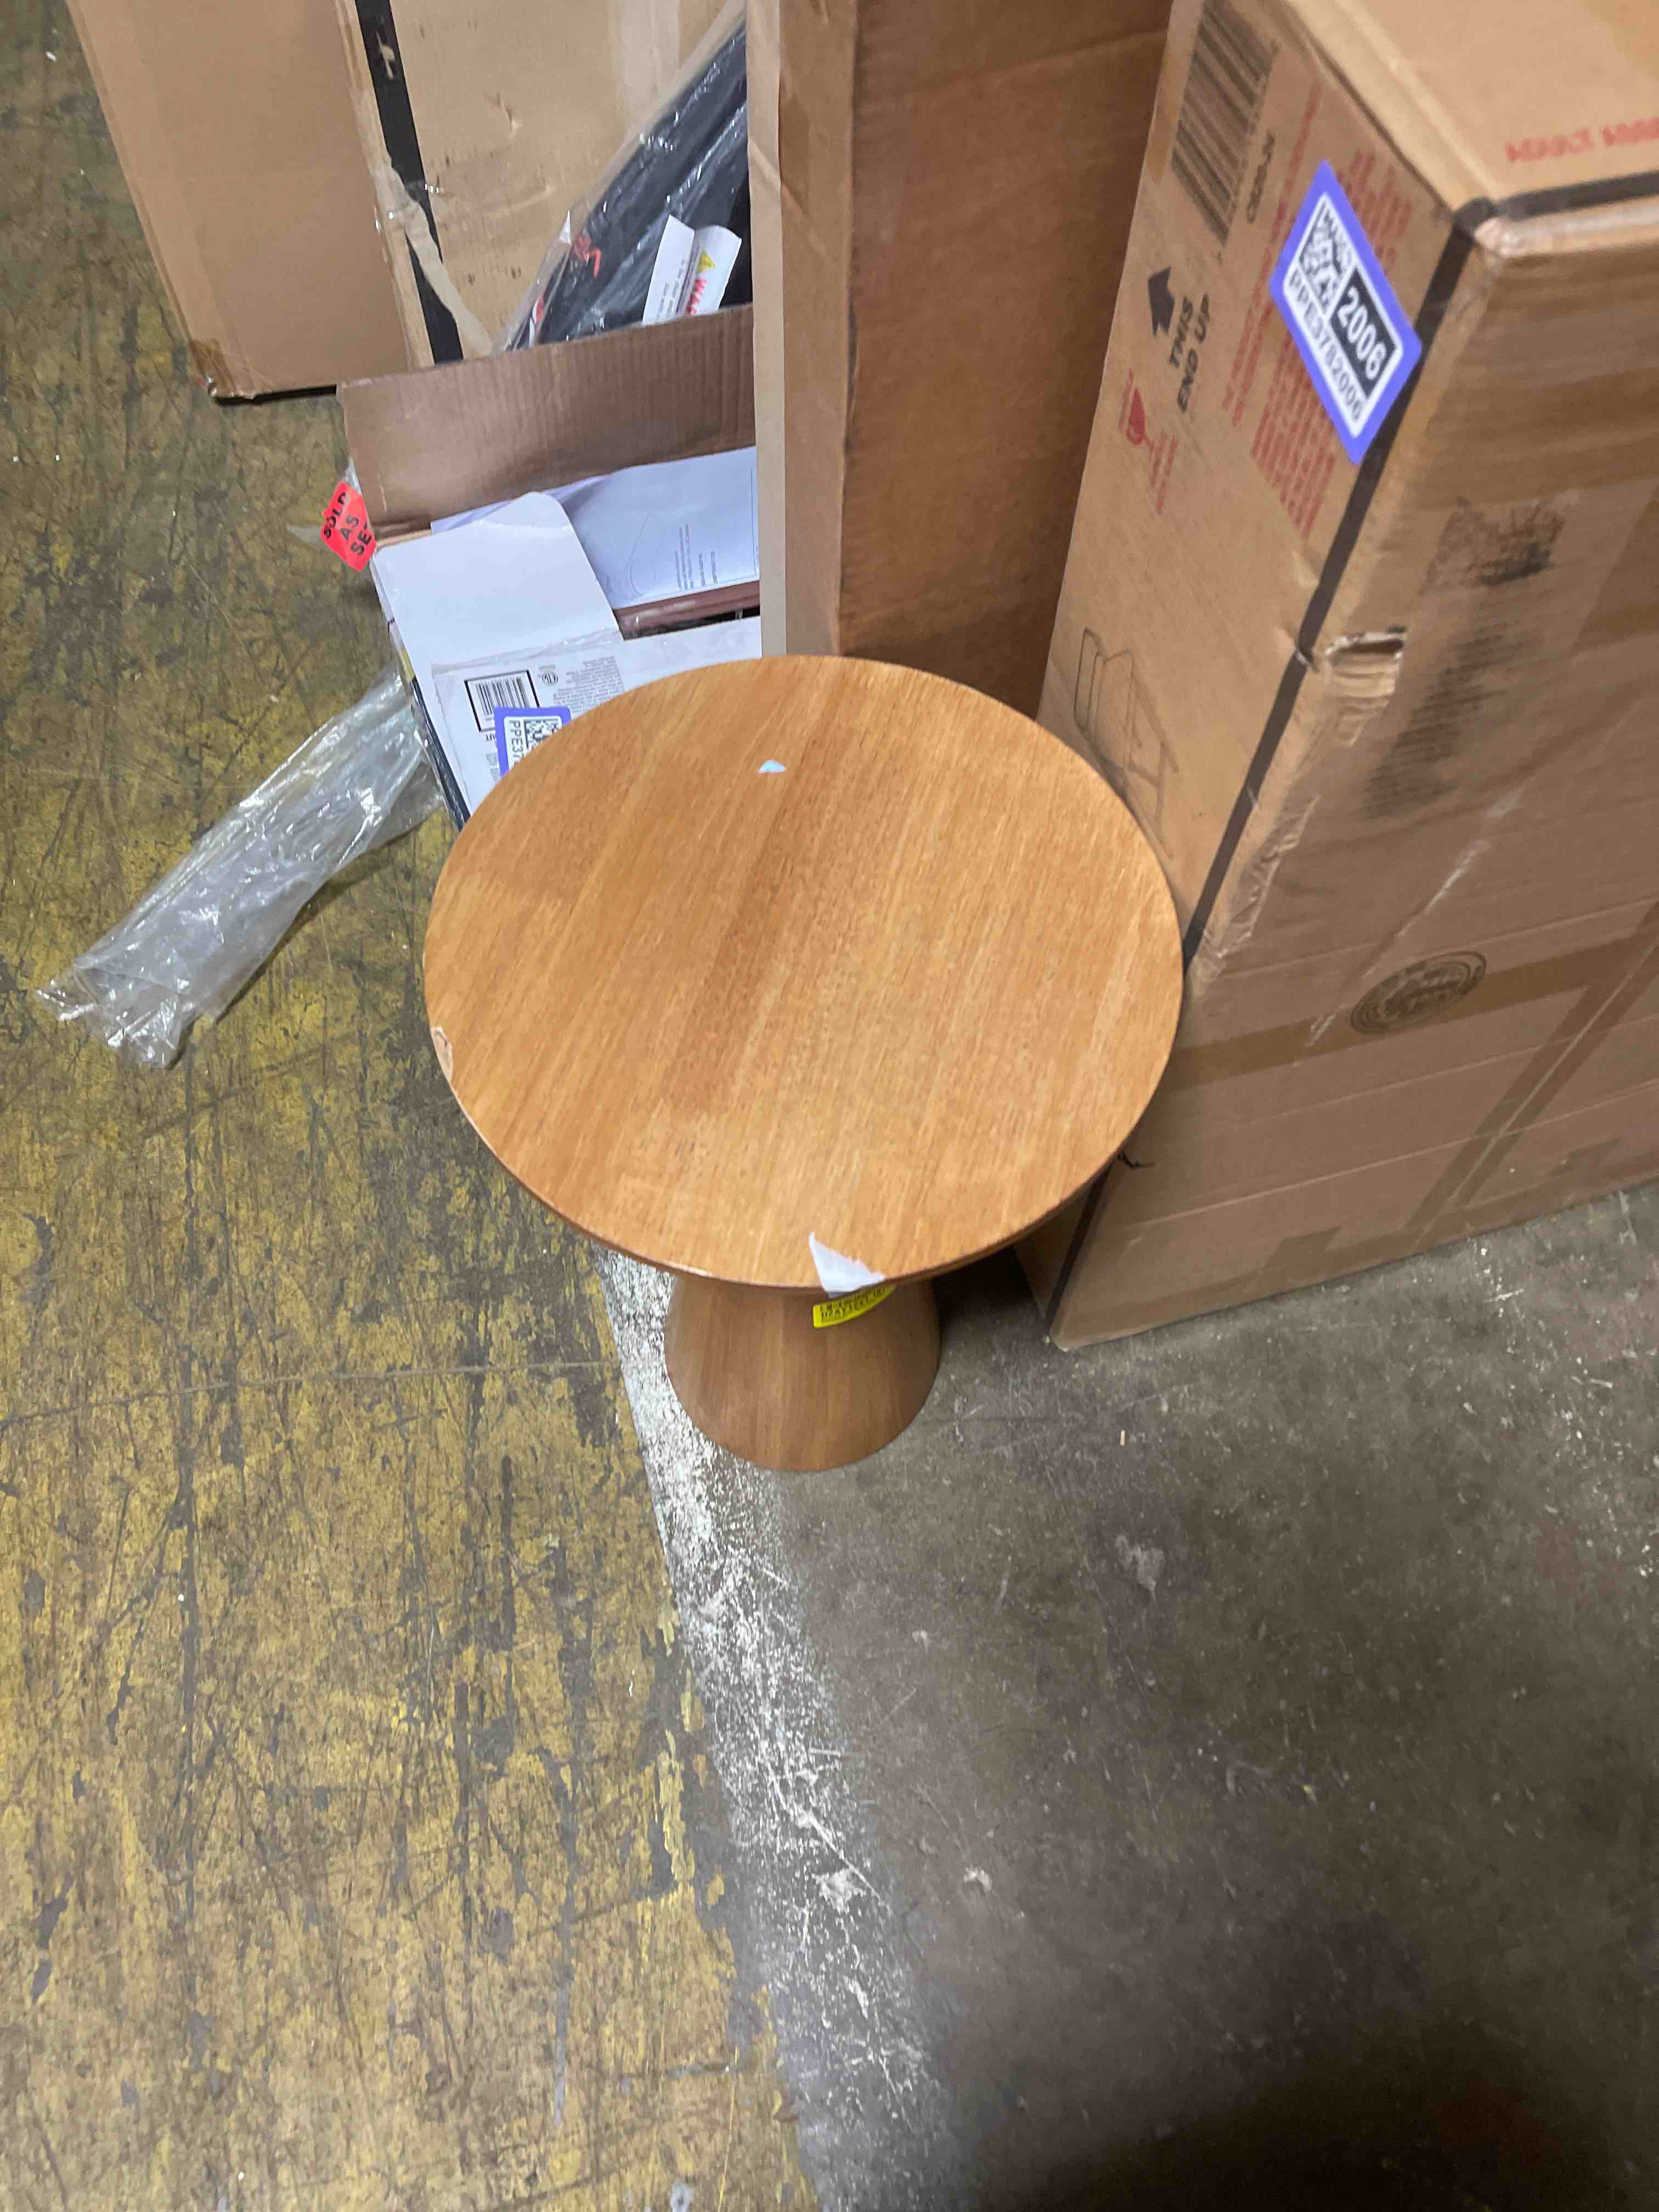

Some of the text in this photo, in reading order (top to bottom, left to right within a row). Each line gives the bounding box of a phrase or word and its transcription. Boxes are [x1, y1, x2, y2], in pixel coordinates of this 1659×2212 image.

[1169, 297, 1193, 368] THIS
[1176, 294, 1210, 413] END UP
[1338, 286, 1386, 380] 2006
[324, 492, 349, 539] SOLD
[340, 515, 359, 541] AS
[509, 720, 524, 761] PPE37
